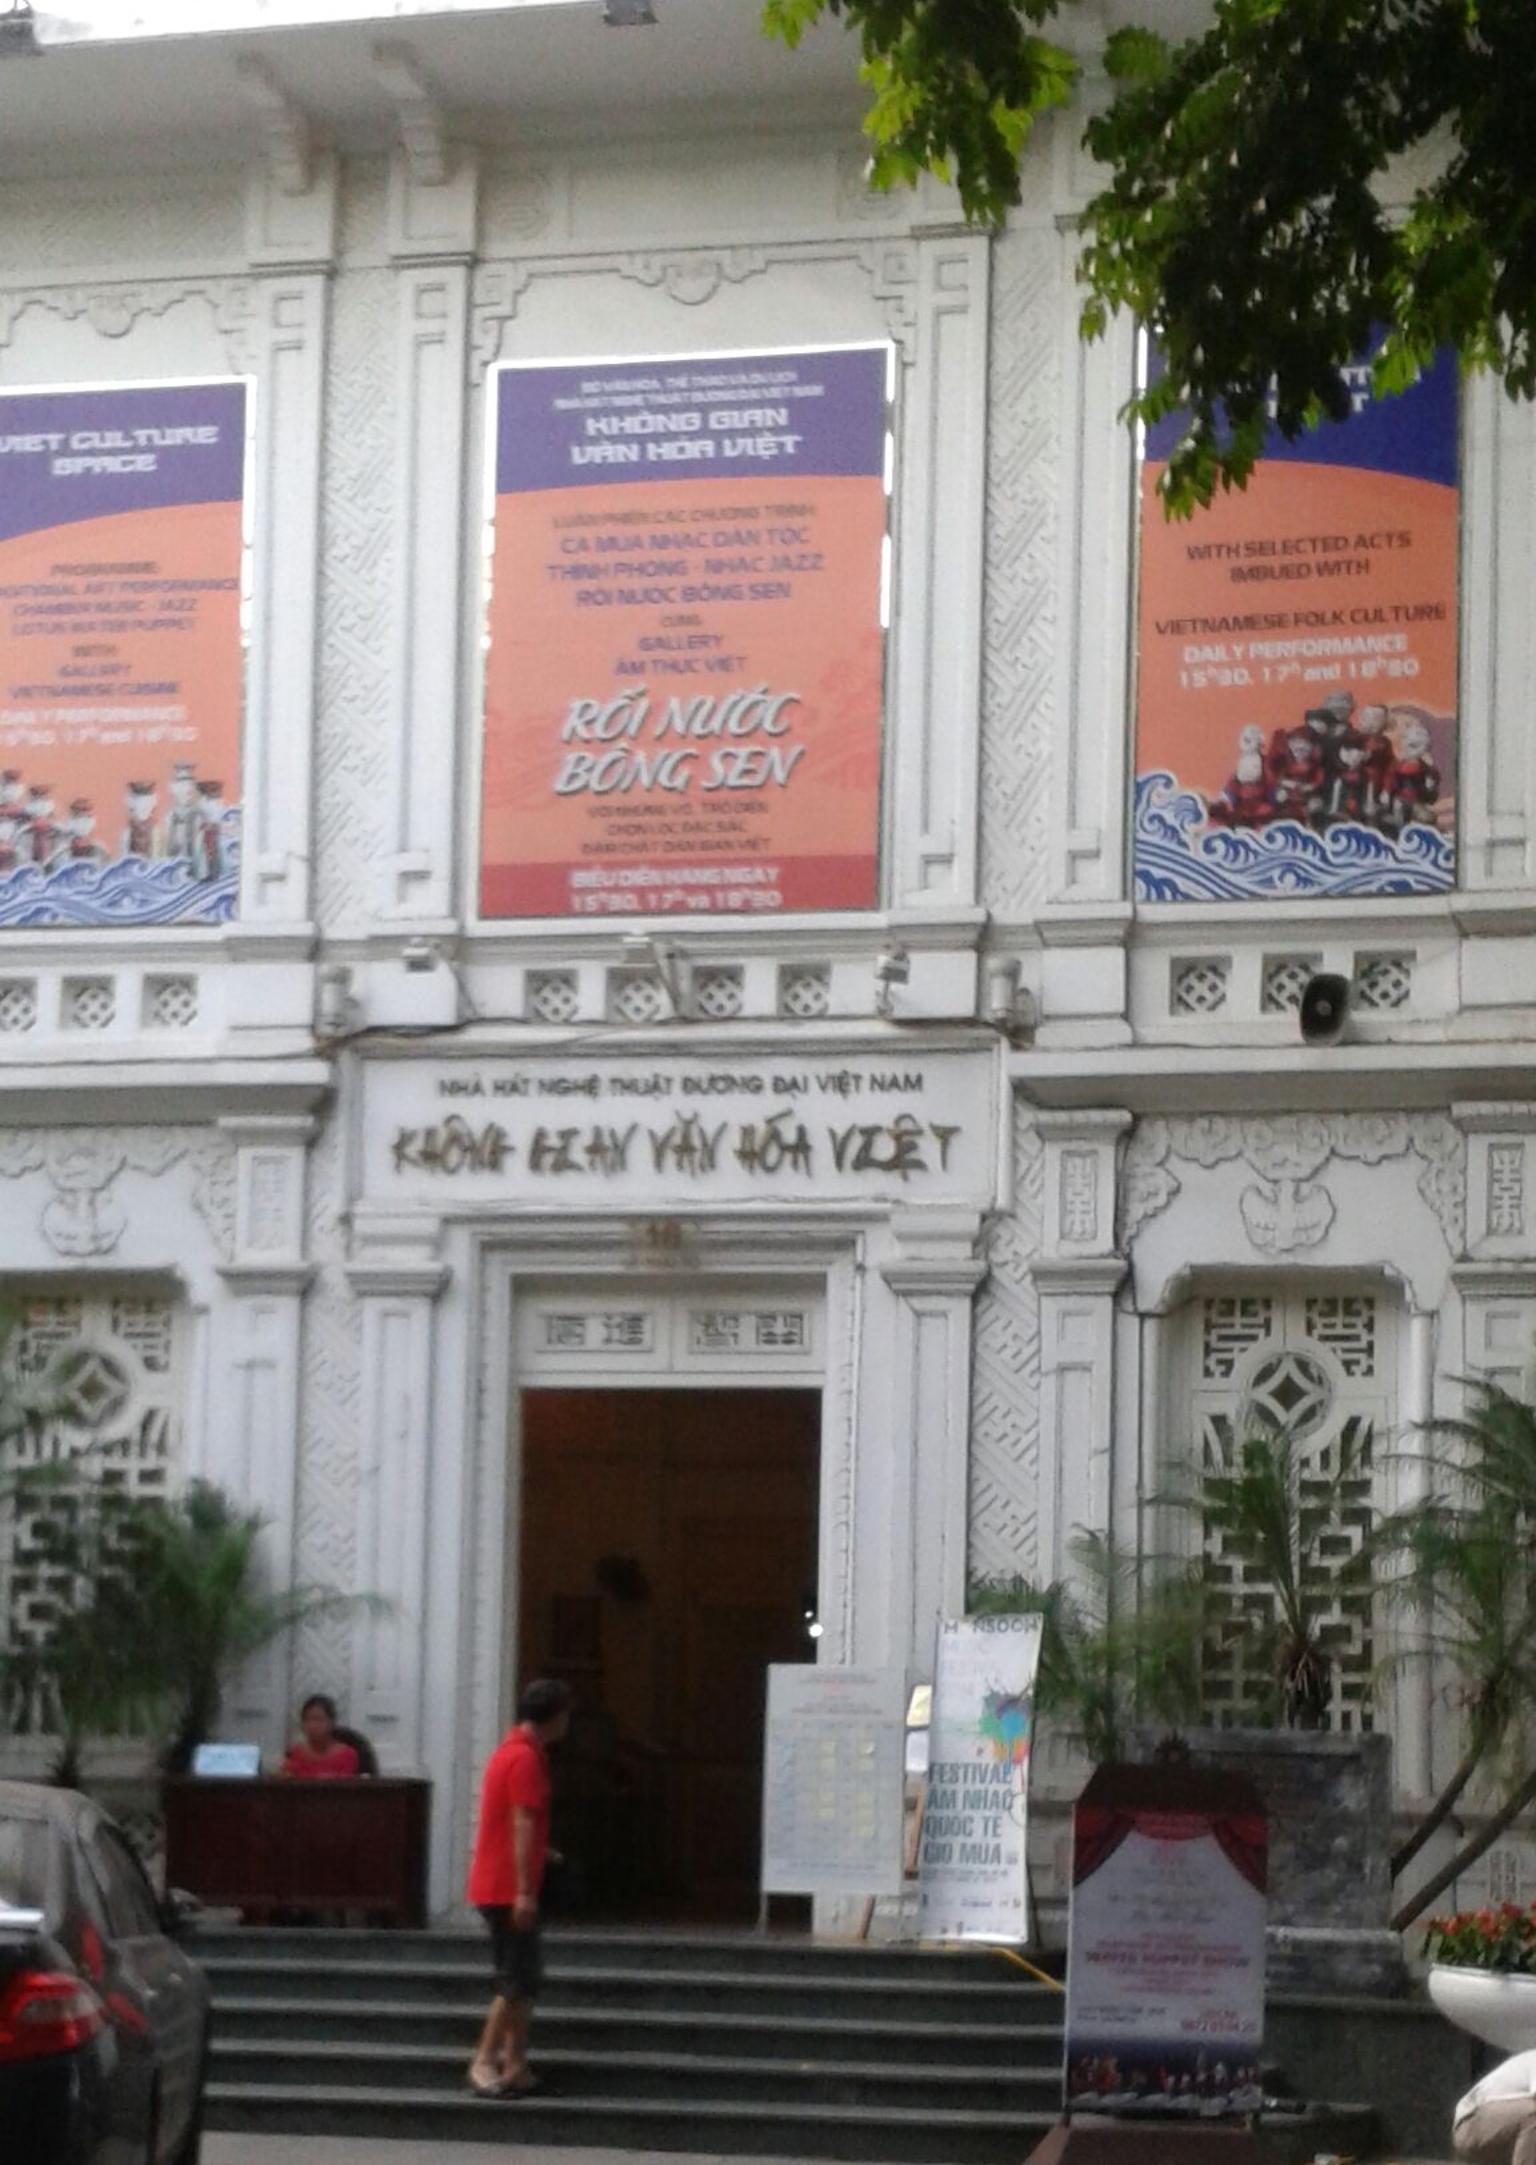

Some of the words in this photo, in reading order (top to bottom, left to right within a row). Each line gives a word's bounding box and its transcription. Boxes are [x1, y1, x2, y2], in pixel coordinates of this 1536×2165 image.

[585, 409, 702, 437] KHÔNG
[707, 407, 789, 431] GIAN
[70, 425, 219, 450] CULTURE
[722, 430, 803, 460] VIỆT
[51, 453, 157, 475] SPACE
[1187, 542, 1241, 561] WITH
[1243, 536, 1349, 559] SELECTED
[1353, 530, 1412, 551] ACTS
[1316, 559, 1370, 578] WITH
[1154, 613, 1290, 636] VIETNAMESE
[1293, 609, 1345, 629] FOLK
[1350, 602, 1447, 625] CULTURE
[1183, 644, 1243, 665] DAILY
[1249, 633, 1408, 660] PERFORMANCE
[1303, 664, 1341, 681] and
[560, 684, 650, 744] RỐI
[655, 680, 801, 740] NƯỚC
[553, 740, 698, 797] BÔNG
[702, 744, 806, 793] SEN
[814, 1069, 862, 1101] VIỆT
[869, 1072, 924, 1094] NAM
